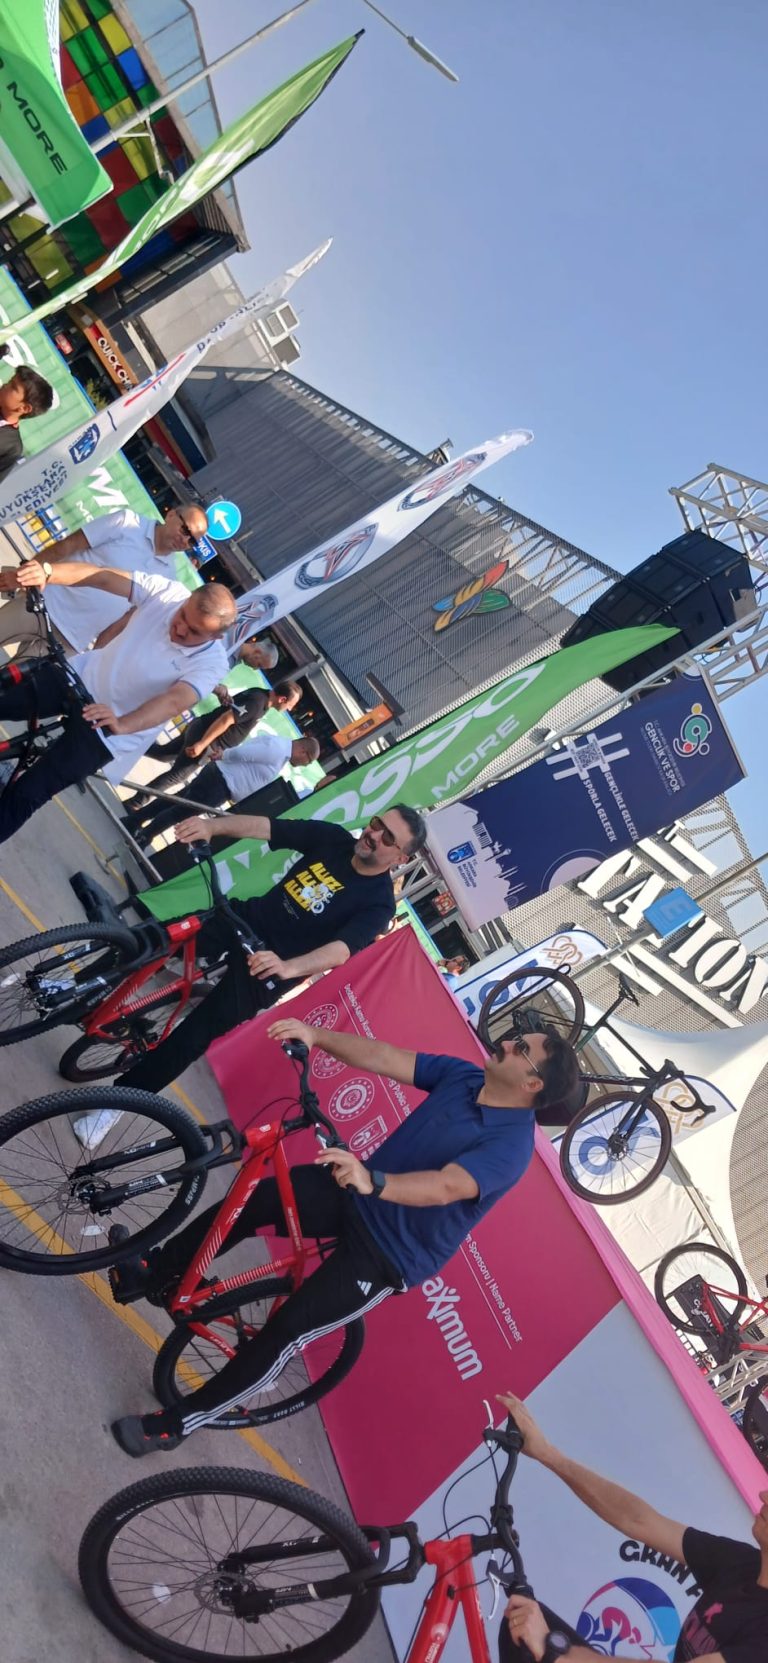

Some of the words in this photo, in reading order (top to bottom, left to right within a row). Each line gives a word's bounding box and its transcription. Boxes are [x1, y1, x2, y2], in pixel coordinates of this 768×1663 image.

[6, 81, 68, 175] MORE
[98, 338, 122, 374] QUICK
[431, 714, 520, 800] MORE
[661, 757, 671, 770] VE
[666, 769, 680, 792] SPOR
[583, 779, 602, 809] SPORLA
[597, 808, 617, 843] GELECEK
[621, 809, 640, 841] GELECEK
[393, 1082, 405, 1106] Public
[468, 1241, 491, 1280] Sponsoru
[489, 1283, 505, 1309] Name
[502, 1307, 523, 1342] Partner
[421, 1276, 483, 1381] aximum
